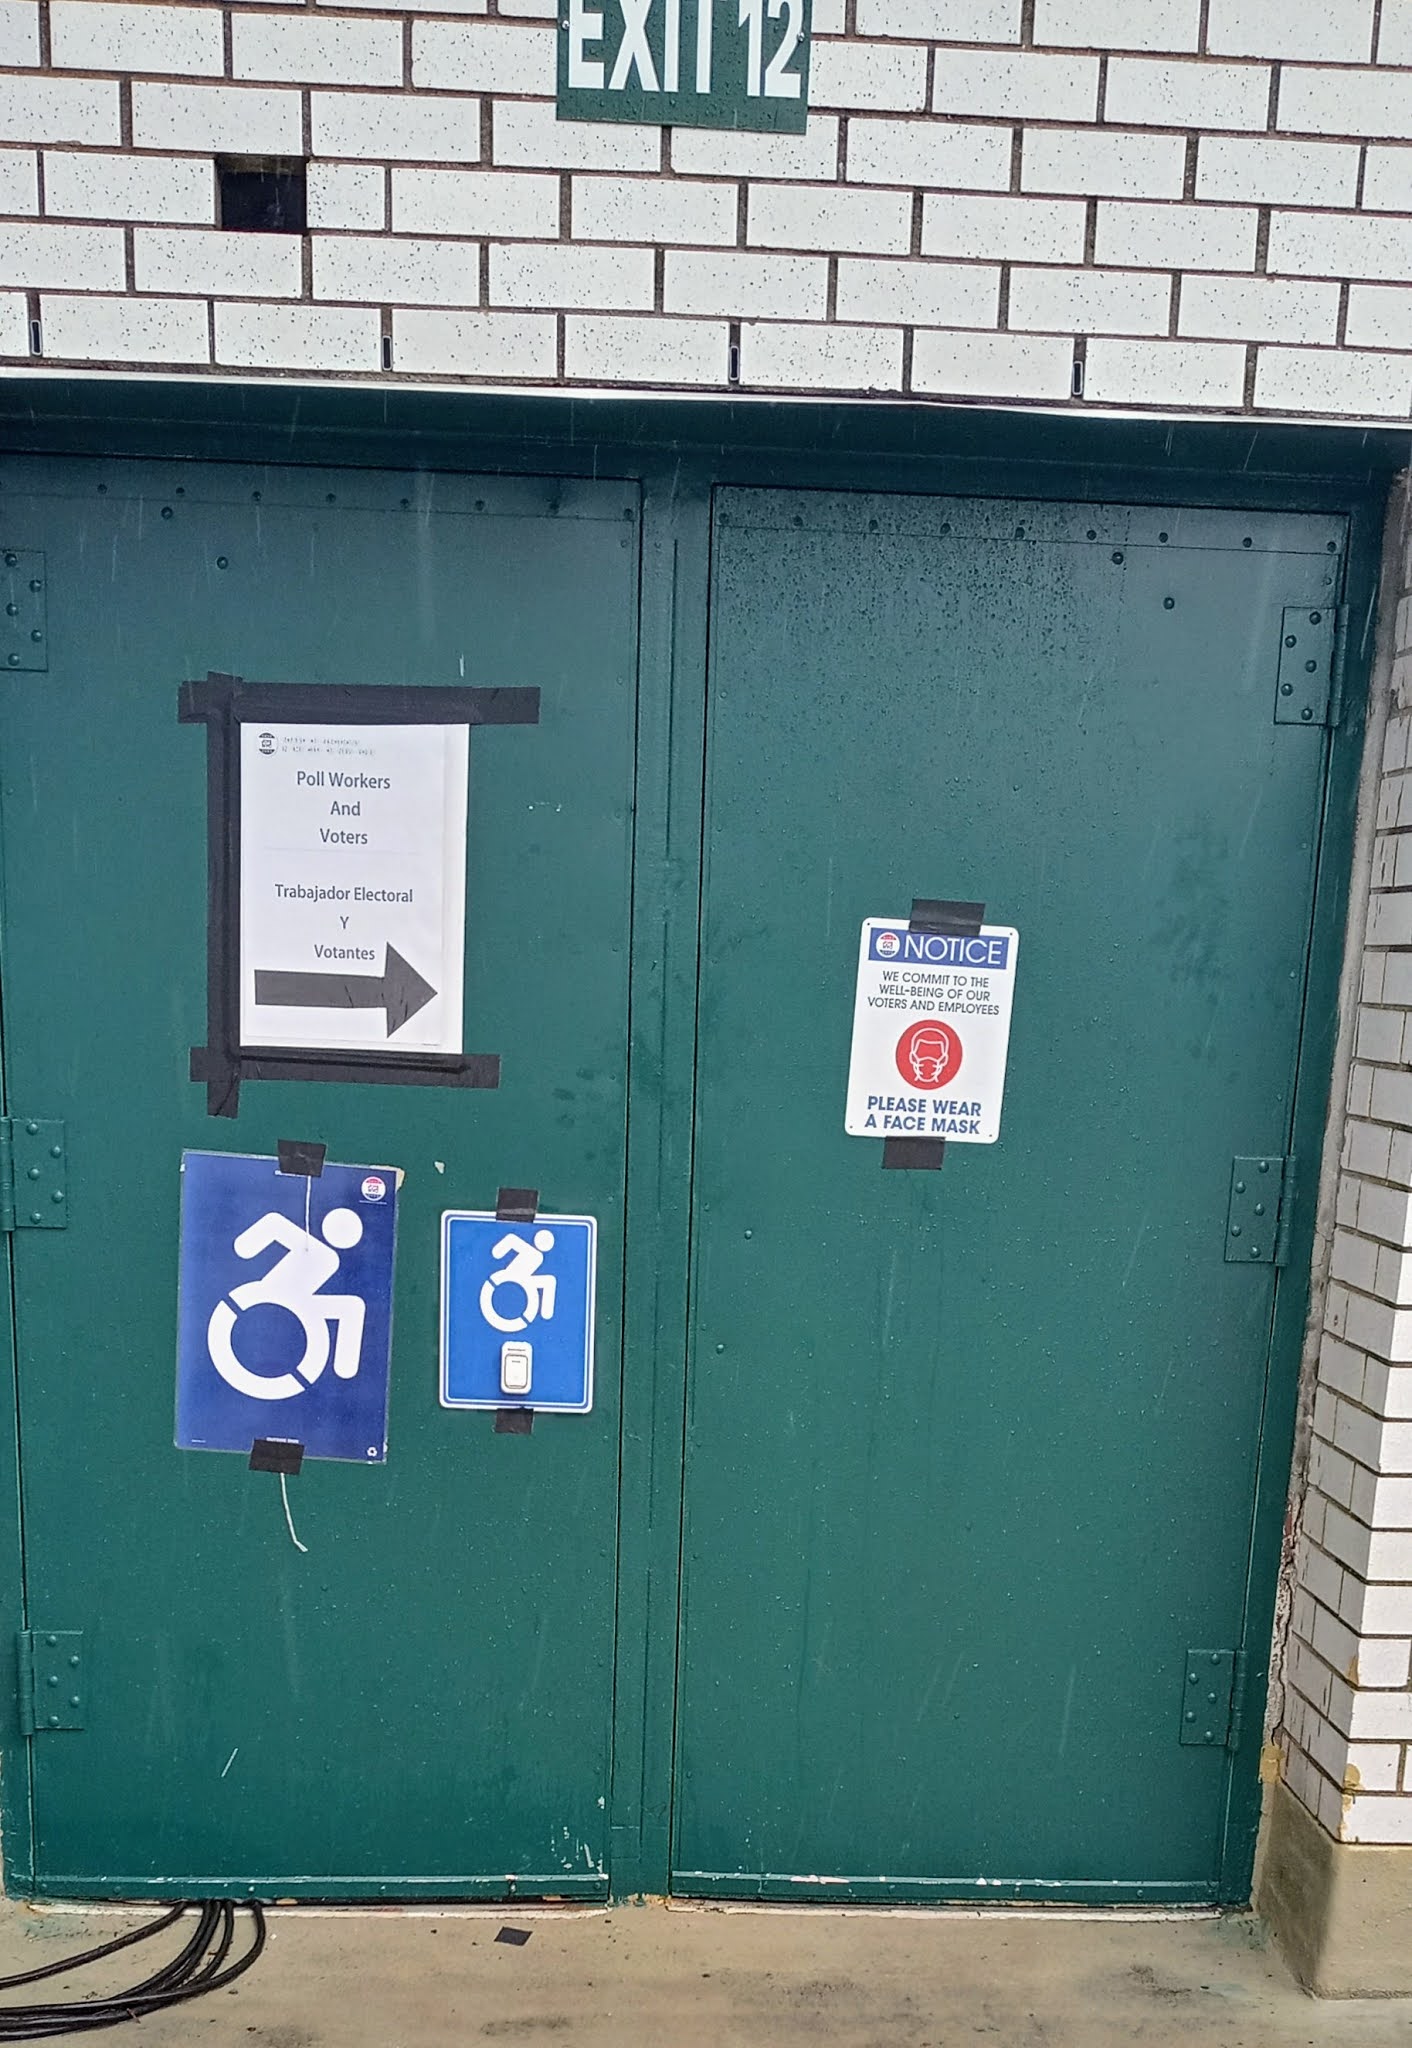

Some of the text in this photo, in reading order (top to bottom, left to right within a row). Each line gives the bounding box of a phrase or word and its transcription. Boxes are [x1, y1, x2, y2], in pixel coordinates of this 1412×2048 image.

[738, 0, 804, 98] 12
[297, 771, 391, 789] Poll Workers
[330, 801, 361, 816] And
[320, 828, 369, 845] Voters
[275, 884, 413, 902] Trabajador Electoral
[340, 916, 349, 929] Y
[314, 944, 376, 960] Votantes
[904, 935, 1002, 965] NOTICE
[883, 971, 989, 988] WE COMMIT TO THE
[879, 984, 990, 1001] WELL-BEING OF OUR
[868, 997, 1000, 1016] VOTERS AND EMPLOYEES
[868, 1095, 982, 1117] PLEASE WEAR
[864, 1114, 981, 1135] A FACE MASK
